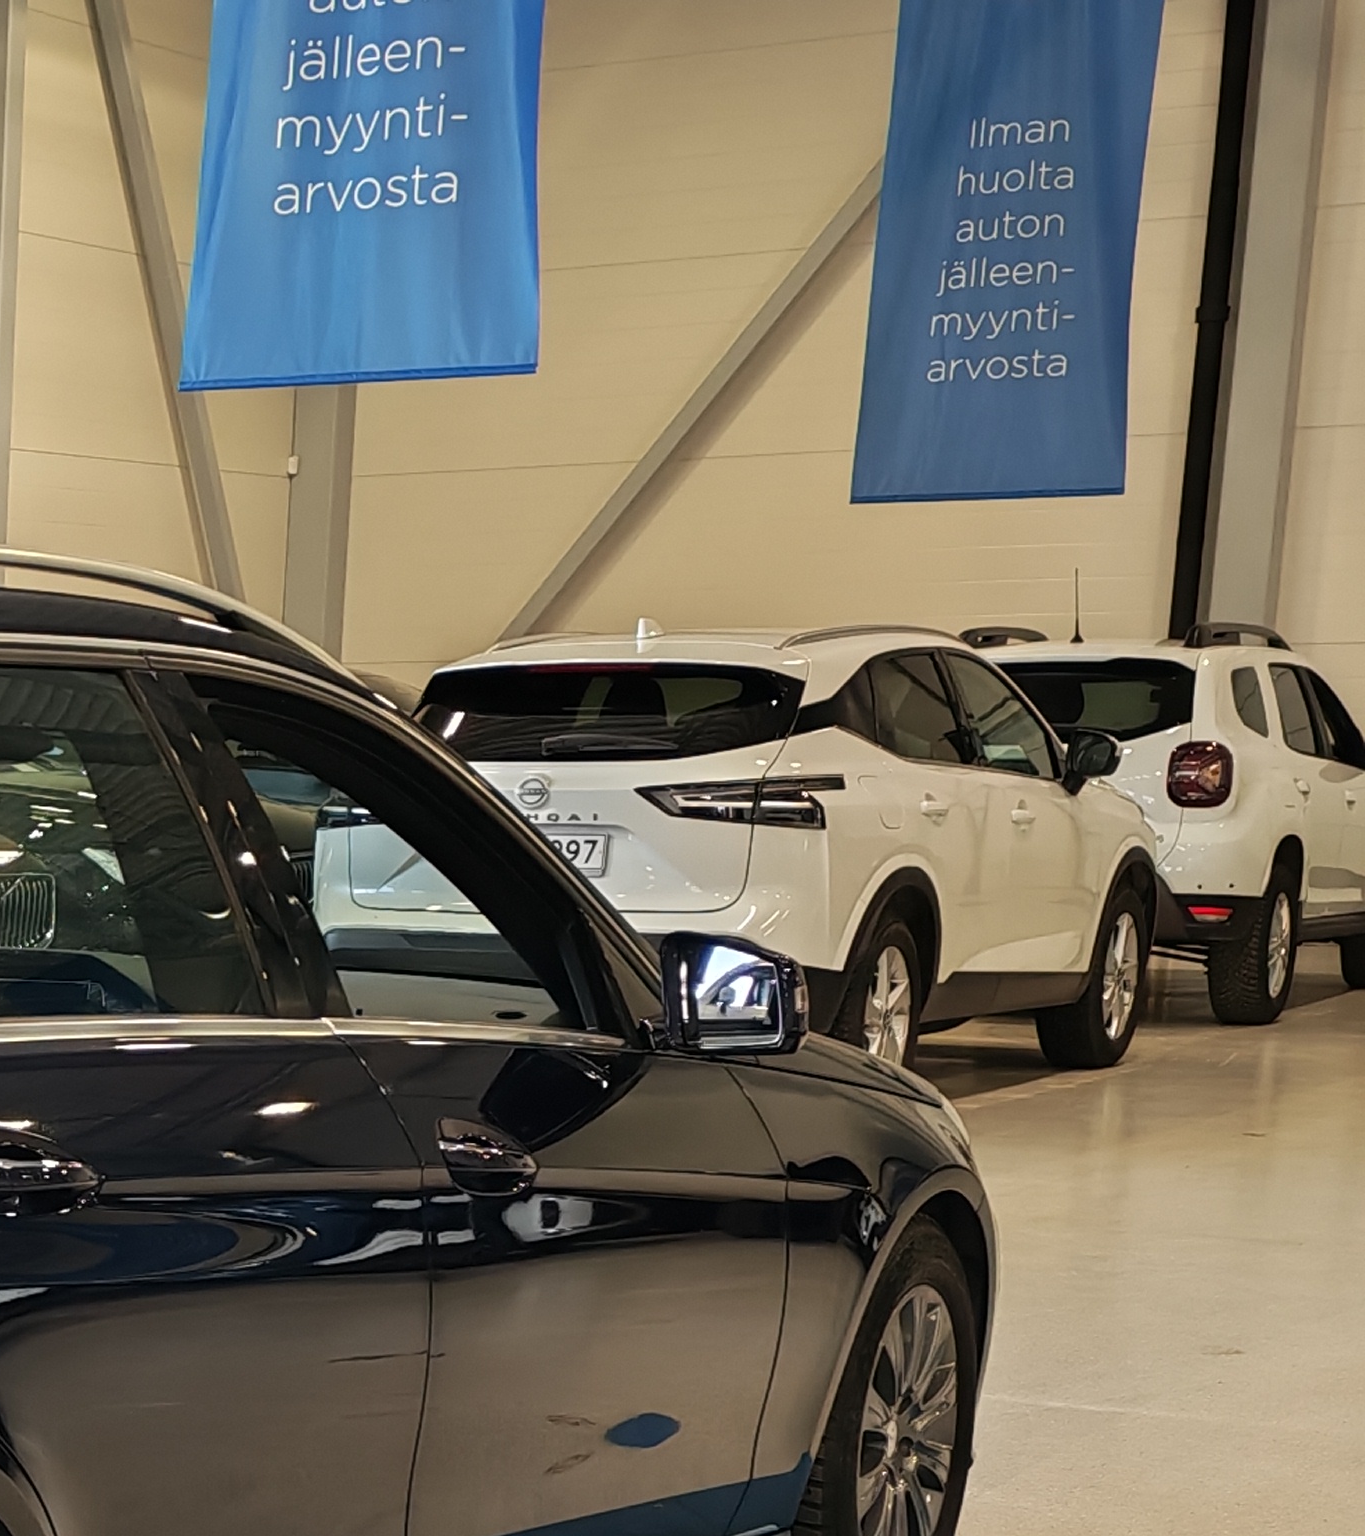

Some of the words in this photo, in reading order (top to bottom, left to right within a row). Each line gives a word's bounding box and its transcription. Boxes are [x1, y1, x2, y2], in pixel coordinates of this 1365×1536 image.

[281, 34, 466, 91] jälleen-
[275, 92, 469, 155] myynti-
[969, 117, 1071, 149] Ilman
[273, 164, 459, 216] arvosta
[957, 159, 1075, 197] huolta
[955, 210, 1065, 243] auton
[935, 256, 1076, 298] jälleen-
[929, 299, 1076, 341] myynti-
[926, 349, 1069, 383] arvosta
